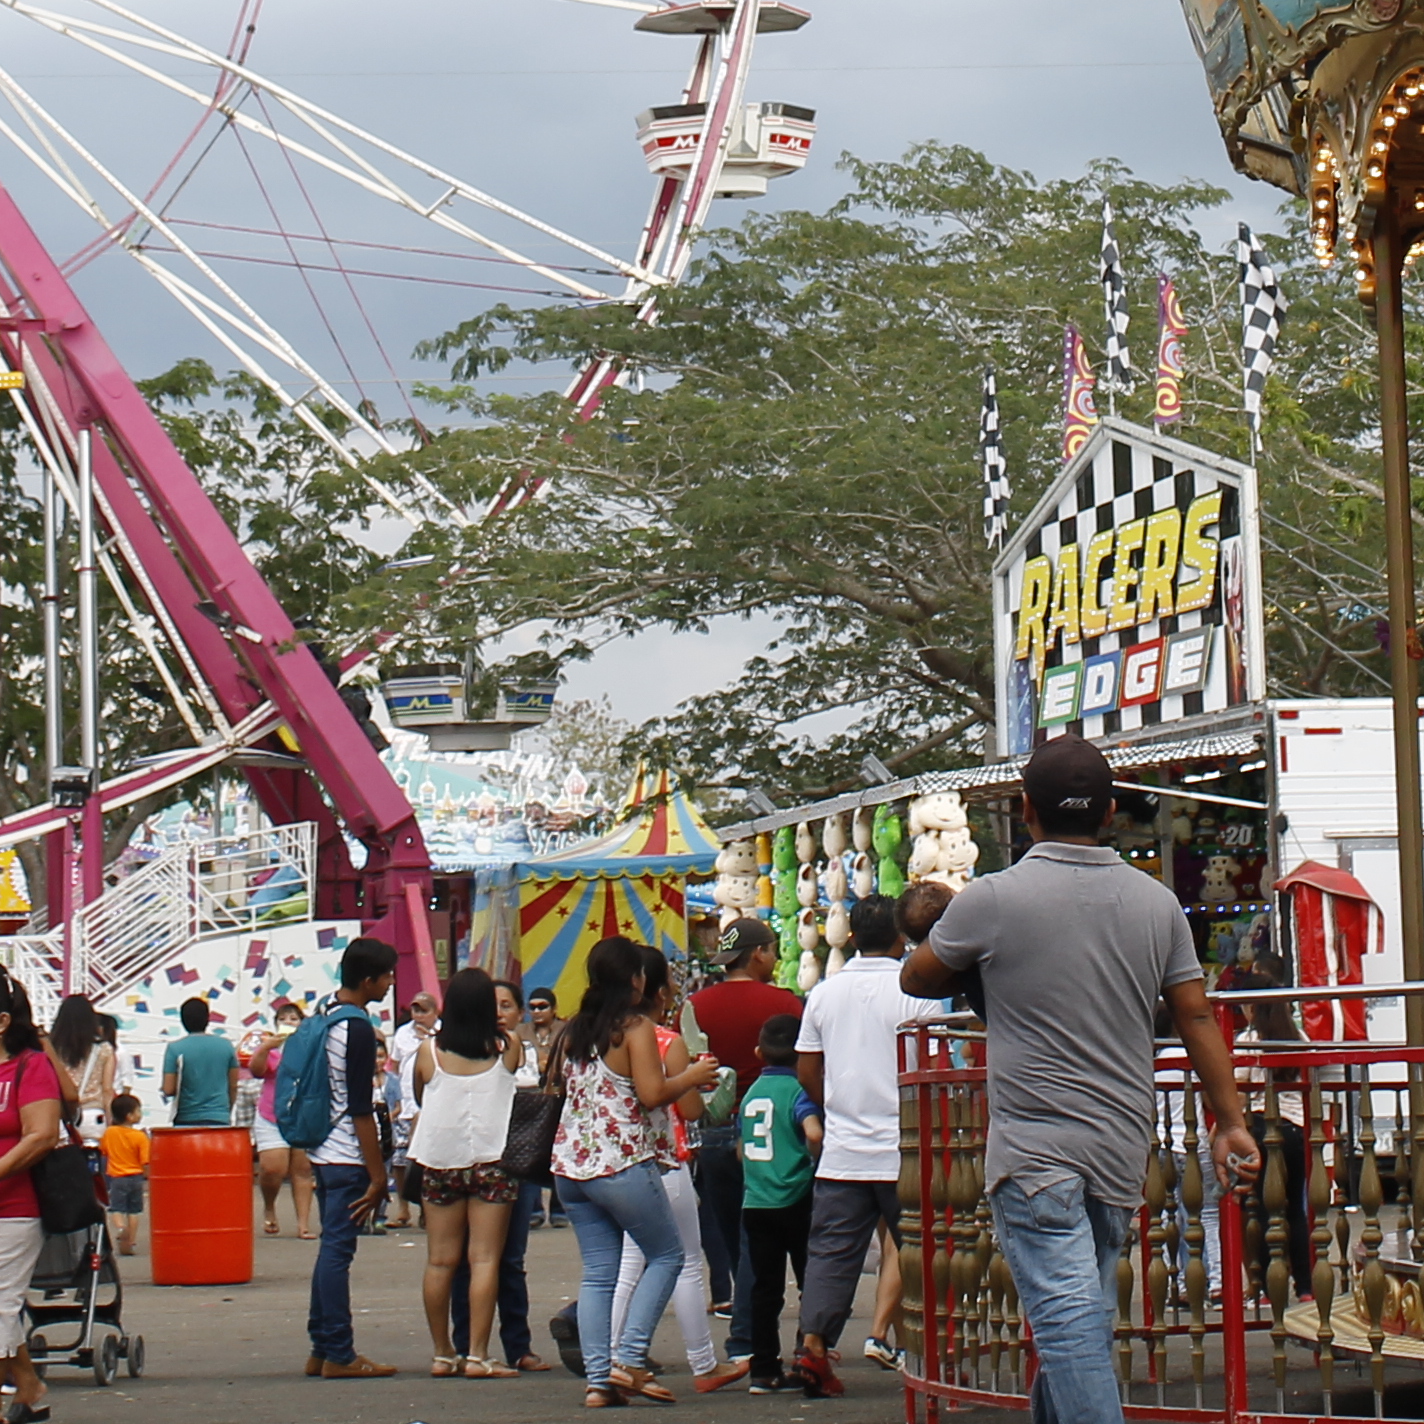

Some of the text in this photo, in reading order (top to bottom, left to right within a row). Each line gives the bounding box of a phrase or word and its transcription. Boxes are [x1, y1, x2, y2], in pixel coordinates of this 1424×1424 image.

[1015, 489, 1222, 694] RACERS
[1040, 632, 1210, 723] EDGE
[744, 1097, 774, 1161] 3
